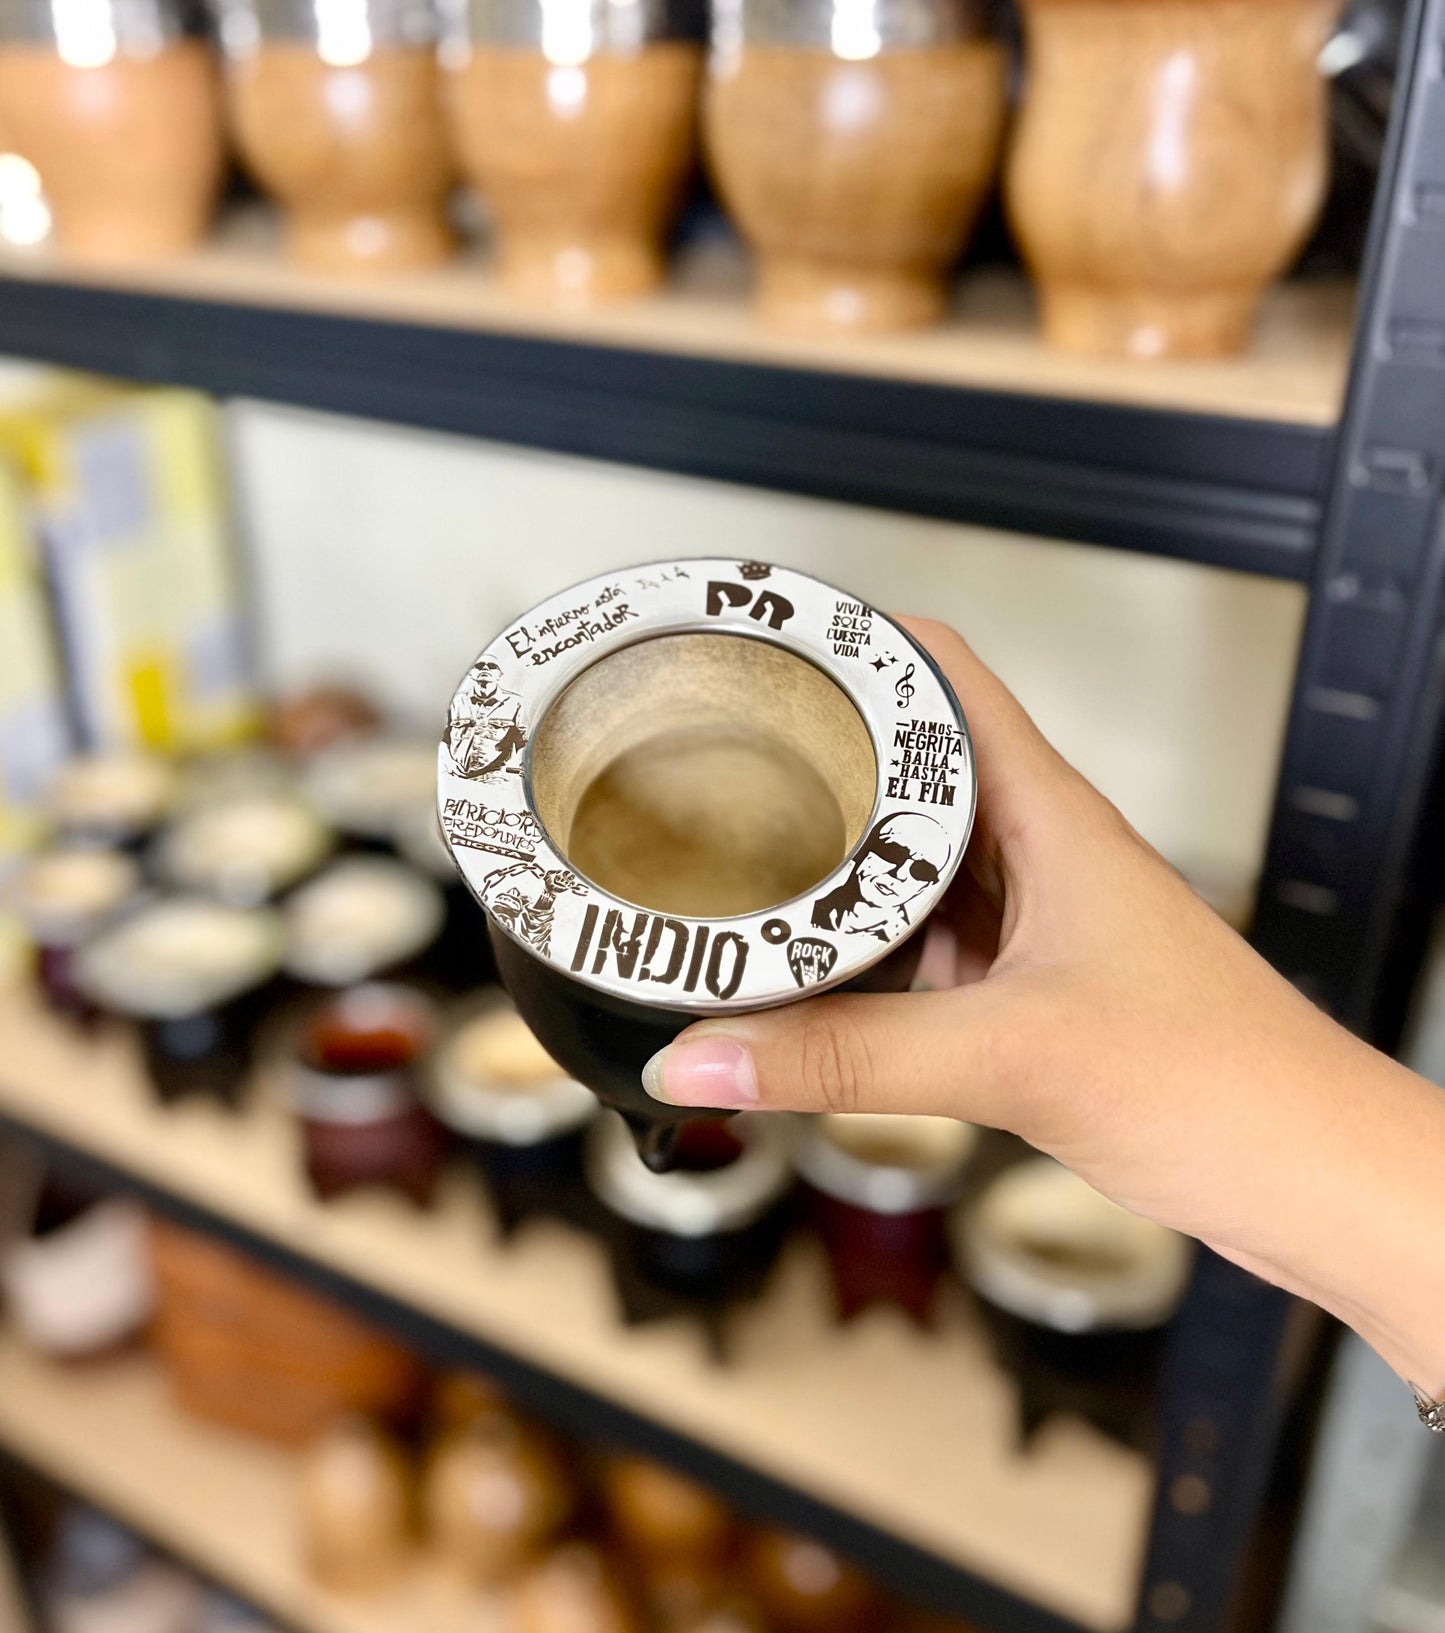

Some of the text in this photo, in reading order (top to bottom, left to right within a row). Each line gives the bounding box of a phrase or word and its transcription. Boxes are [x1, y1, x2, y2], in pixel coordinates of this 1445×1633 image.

[836, 601, 873, 618] VIVIR
[832, 615, 872, 631] SOLO
[505, 626, 536, 659] El
[826, 628, 871, 646] CUESTA
[833, 643, 860, 658] VIDA
[911, 719, 953, 736] VAMOS
[893, 730, 962, 756] NEGRITA
[902, 749, 949, 770] BAILA
[899, 764, 947, 783] HASTA
[885, 776, 957, 806] EL FIN
[570, 903, 750, 1000] INDIO
[791, 941, 832, 968] ROCK
